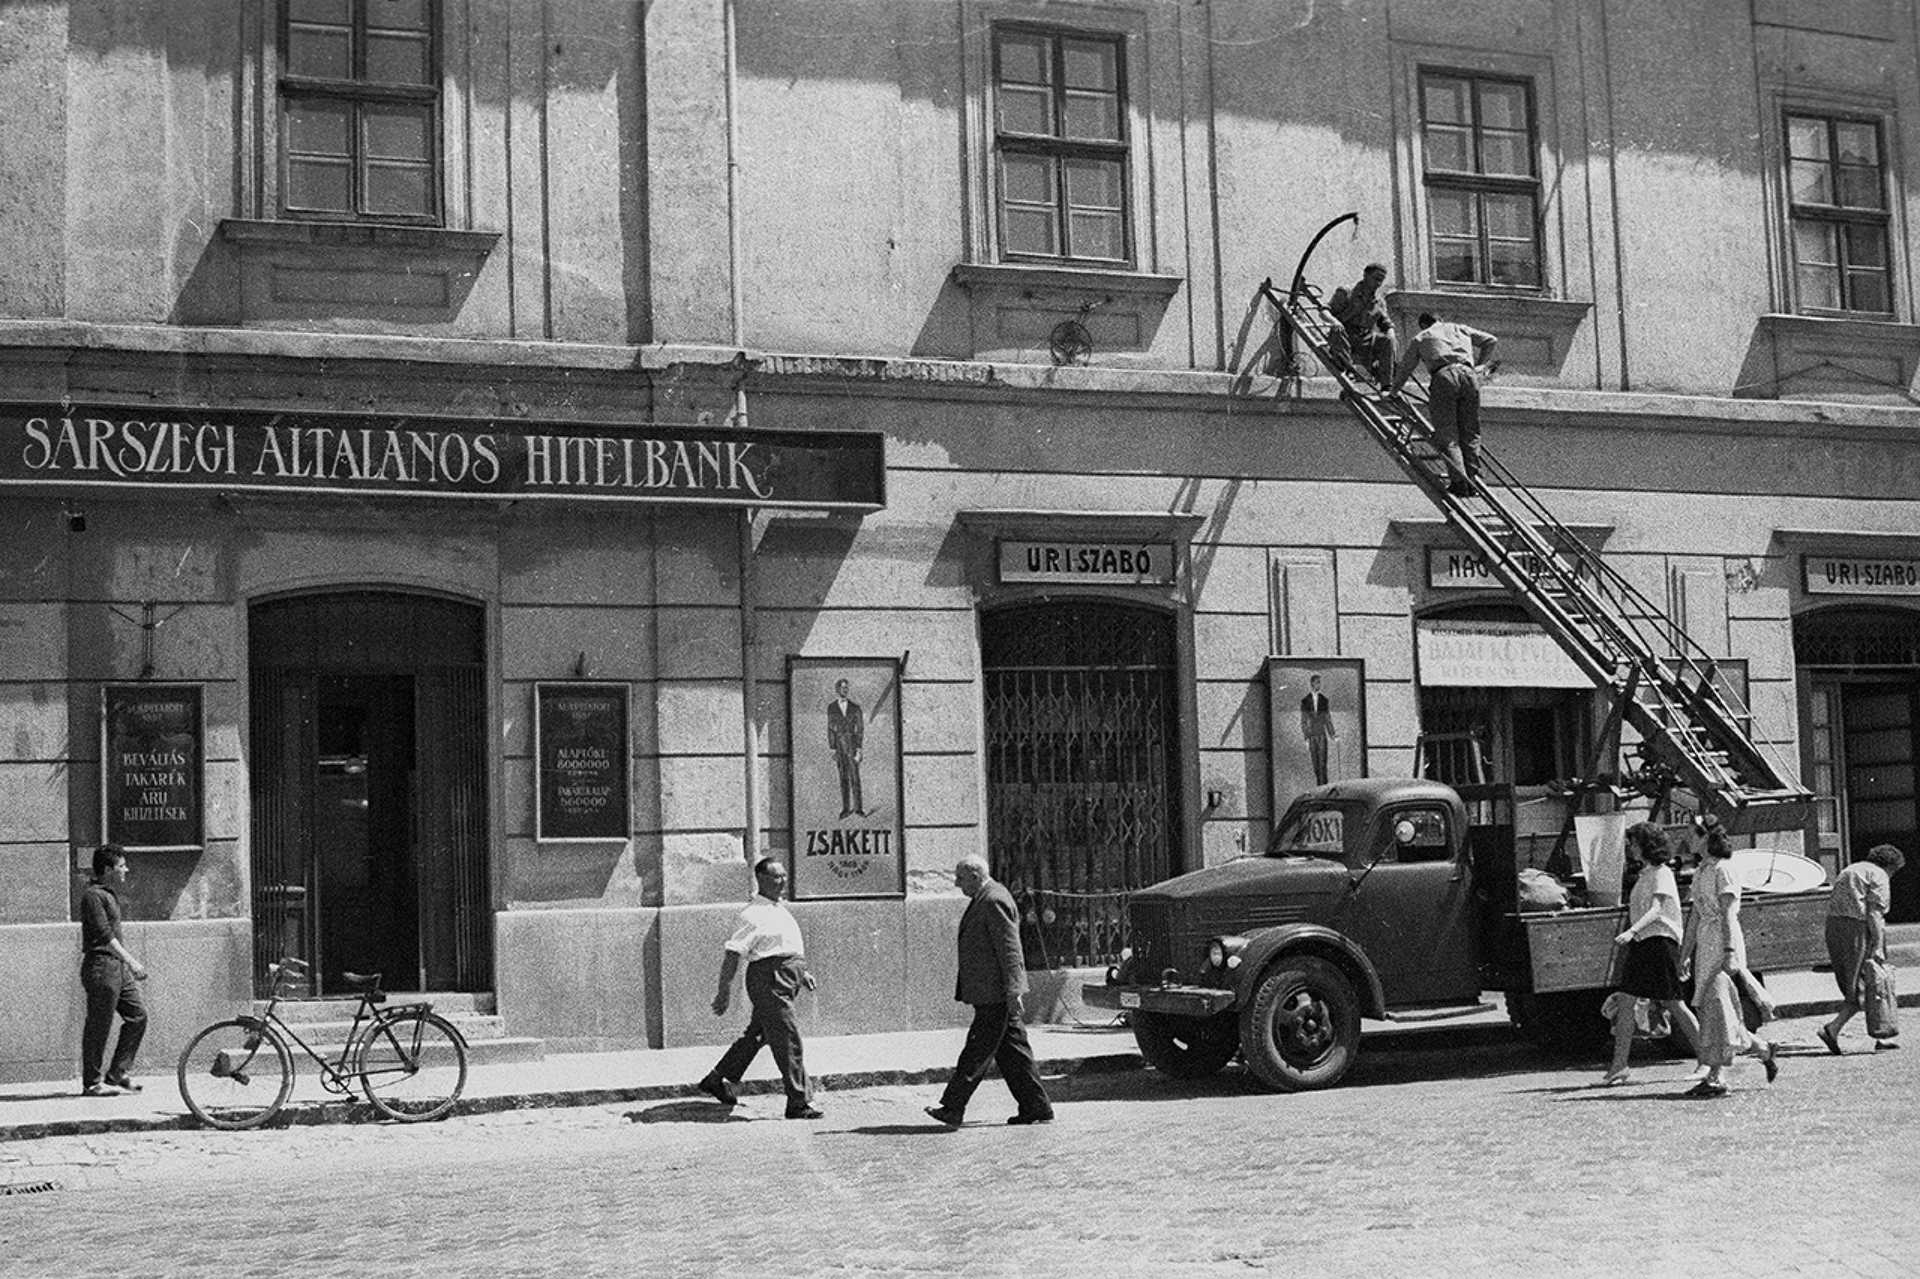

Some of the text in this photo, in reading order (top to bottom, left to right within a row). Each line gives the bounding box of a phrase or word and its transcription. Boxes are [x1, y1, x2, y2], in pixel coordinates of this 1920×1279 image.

[23, 406, 773, 498] SÁRSZEGI ÁLTALÁNOS HITELBANK
[123, 768, 186, 787] TAKARÉK
[806, 828, 892, 857] ZSAKETT
